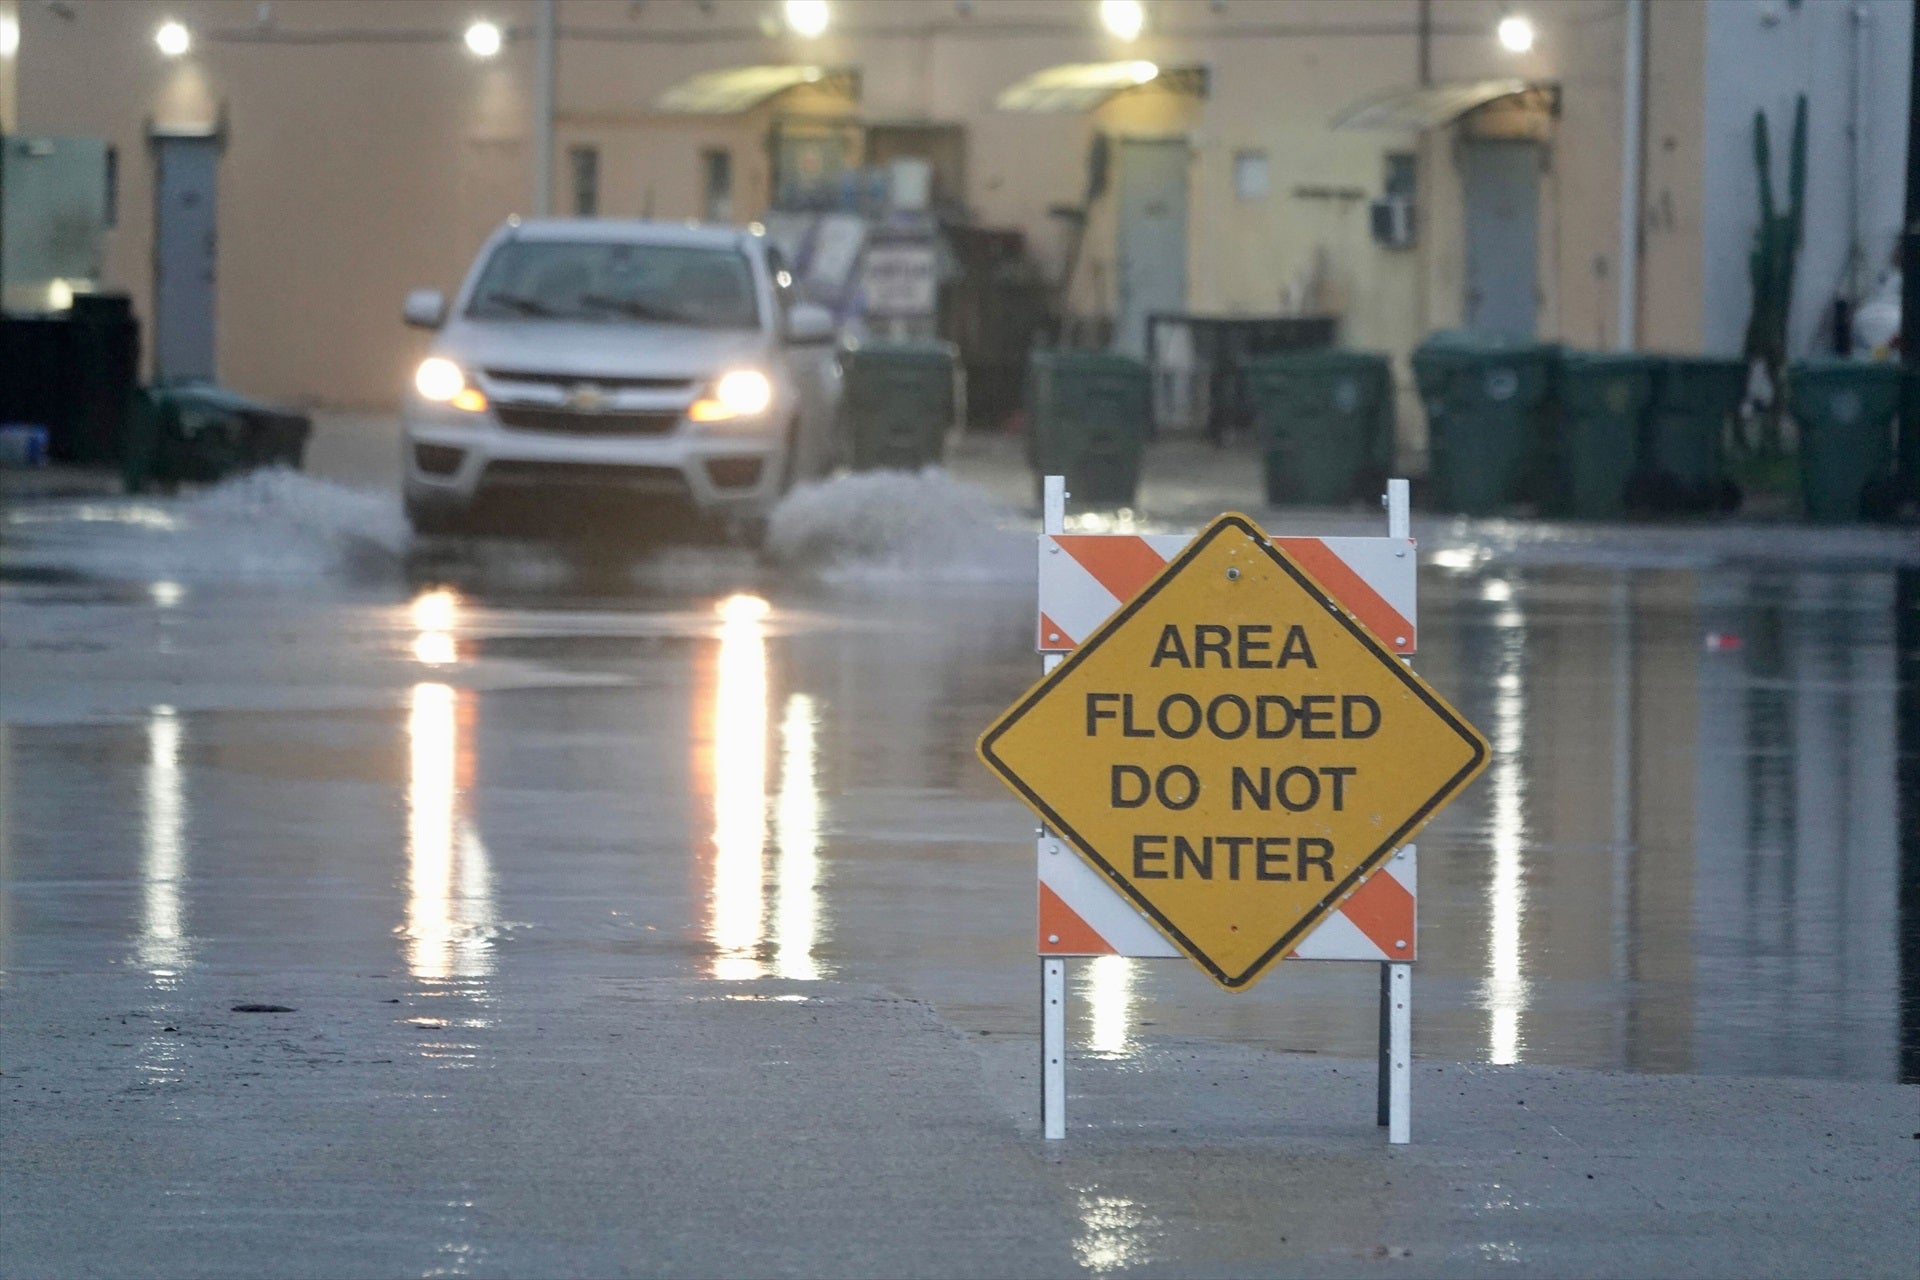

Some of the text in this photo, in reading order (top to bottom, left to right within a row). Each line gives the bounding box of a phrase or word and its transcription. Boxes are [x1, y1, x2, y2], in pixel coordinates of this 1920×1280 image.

[1150, 624, 1318, 669] AREA
[1086, 692, 1382, 740] FLOODED
[1111, 764, 1357, 812] DO NOT
[1133, 834, 1335, 882] ENTER
